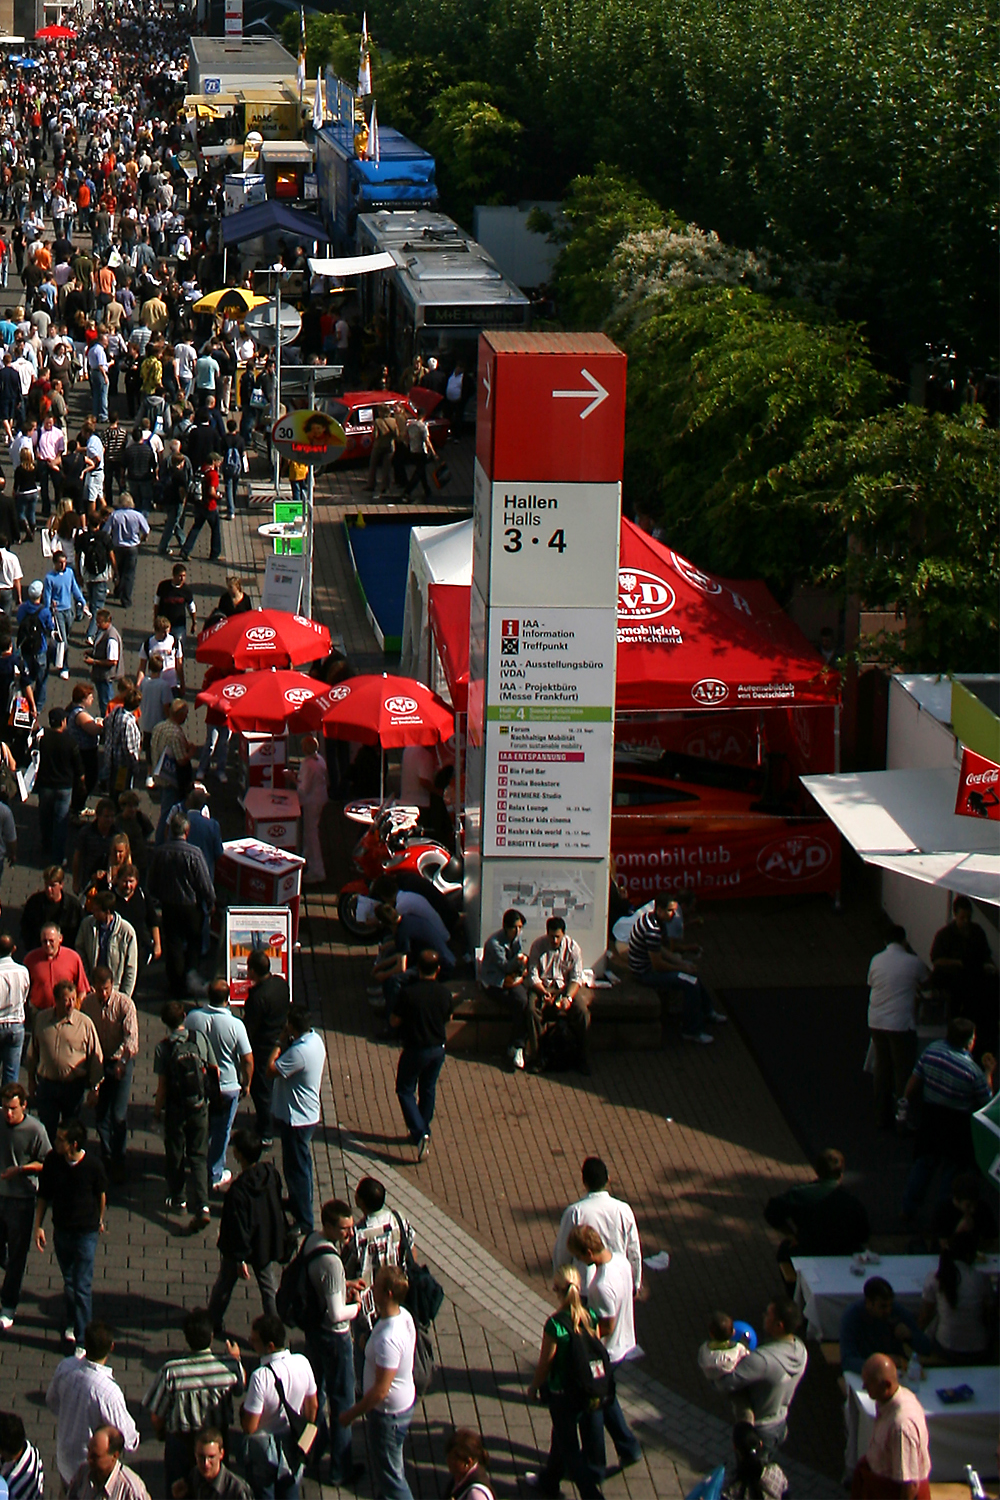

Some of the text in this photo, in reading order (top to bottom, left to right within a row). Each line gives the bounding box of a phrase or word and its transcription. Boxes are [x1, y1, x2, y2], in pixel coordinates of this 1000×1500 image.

[278, 428, 294, 438] 30
[504, 495, 558, 509] Hallen
[504, 512, 541, 526] Halls
[504, 528, 522, 553] 3
[548, 528, 567, 553] 4
[522, 620, 538, 628] IAA
[522, 629, 574, 638] Information
[616, 624, 680, 635] omobilclub
[522, 642, 568, 650] Treffpunkt
[500, 660, 517, 668] IAA
[525, 660, 604, 670] Ausstellungsbüro
[500, 670, 526, 678] (VDA)
[500, 683, 516, 691] IAA
[524, 683, 577, 692] Projektbüro
[738, 683, 794, 692] Automobilclub
[499, 692, 578, 702] (Messe Frankfurt)
[516, 707, 525, 720] 4
[616, 846, 730, 867] omobilclub
